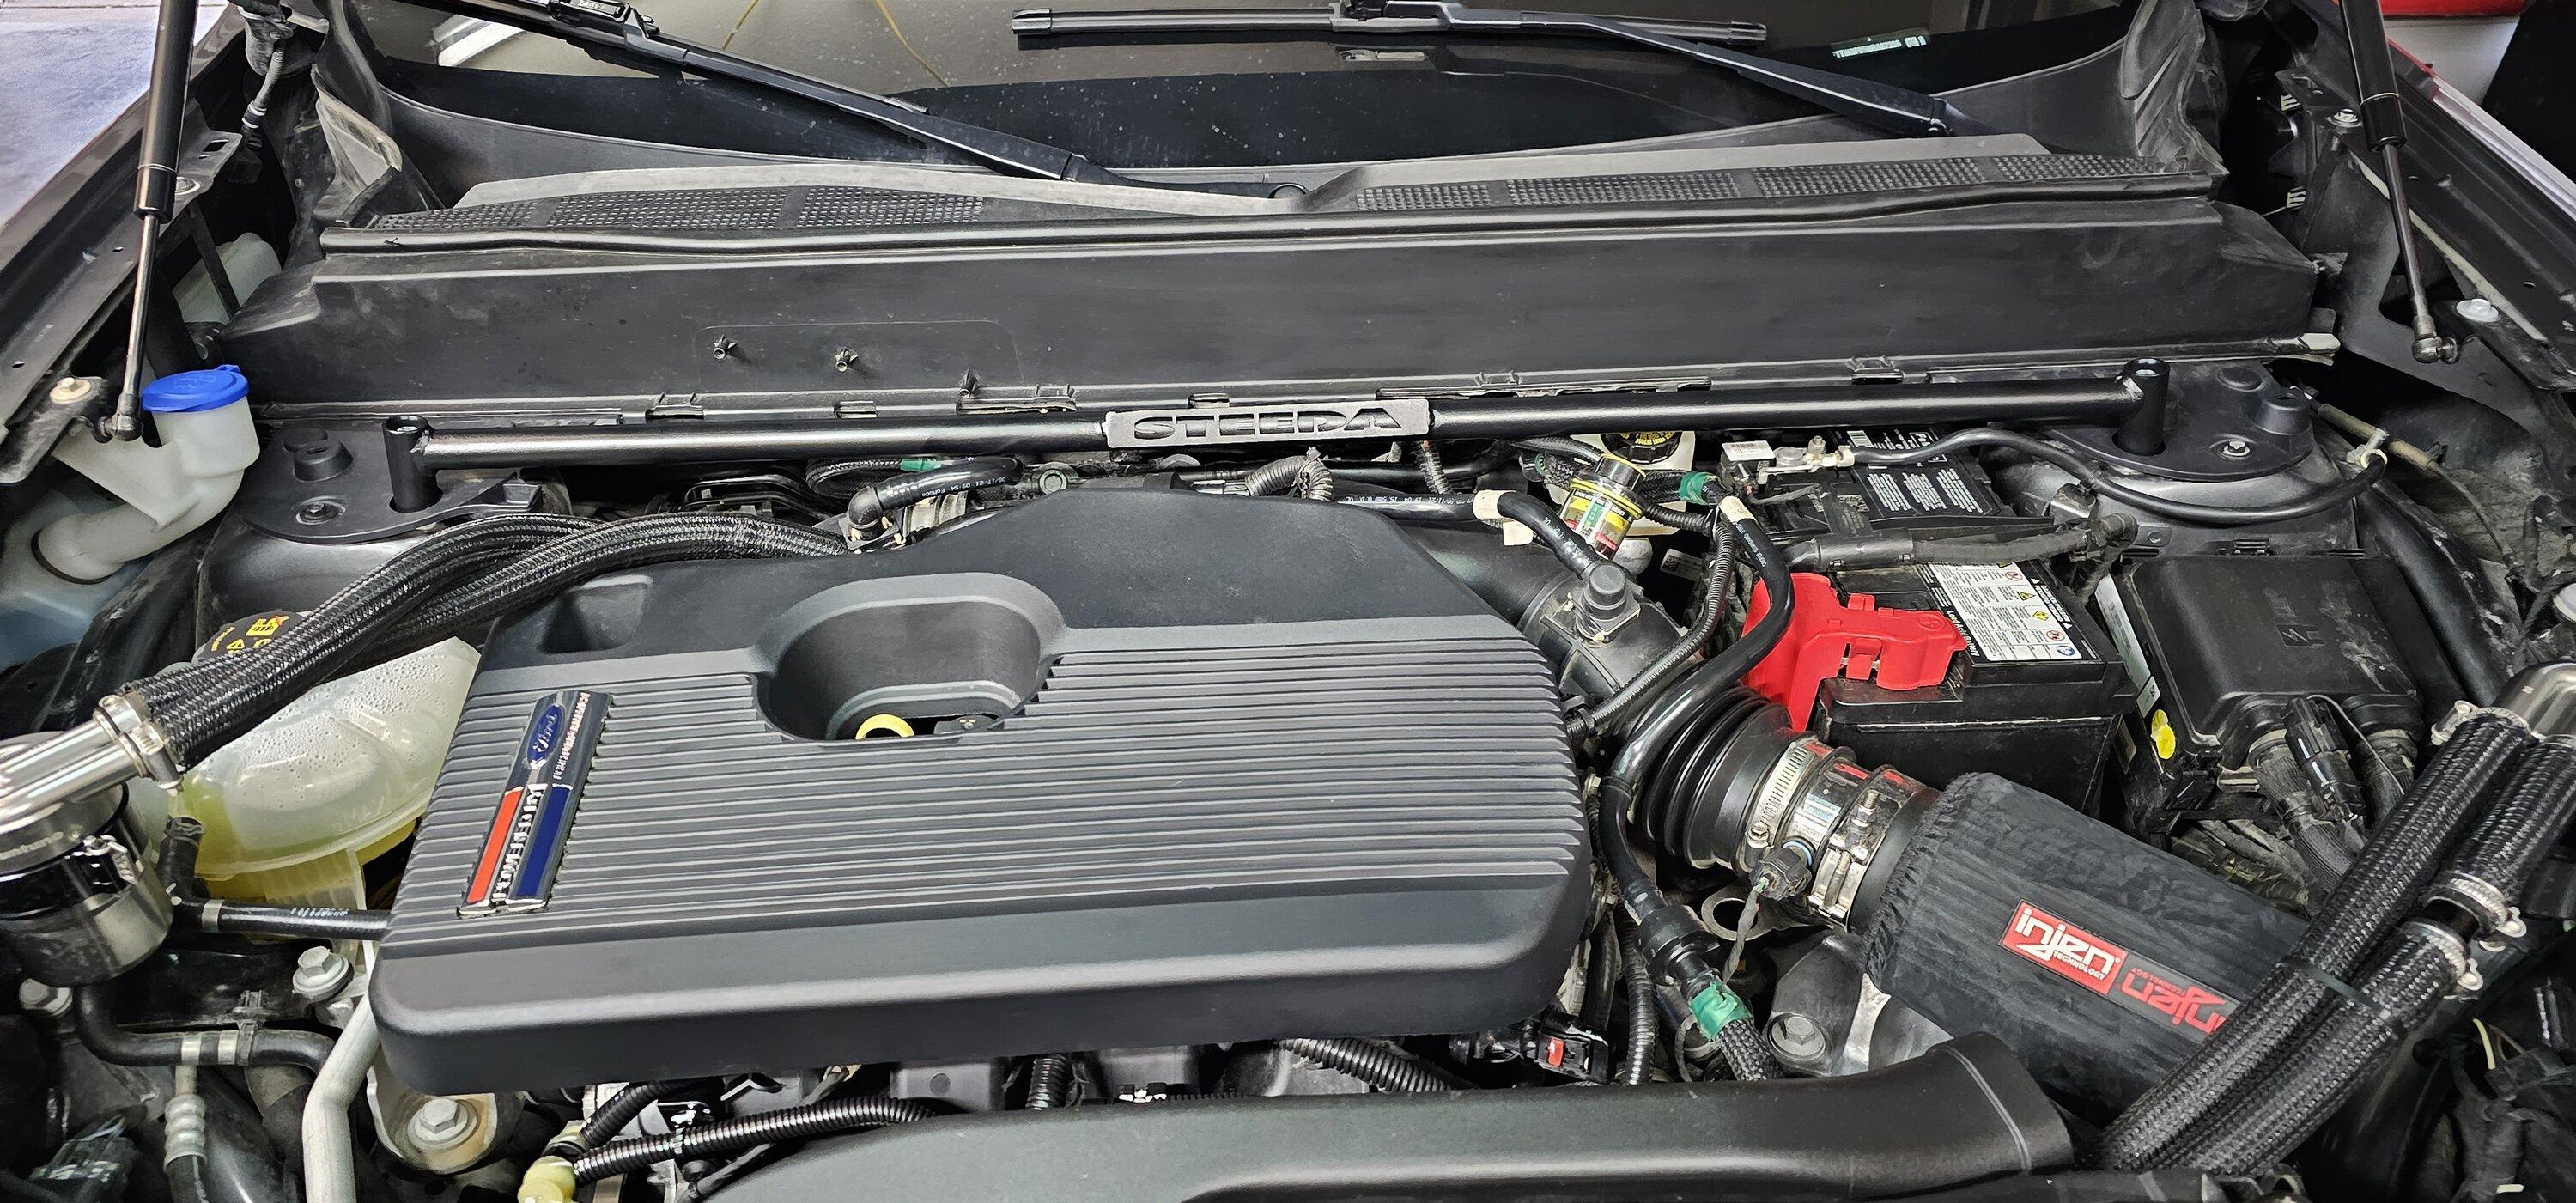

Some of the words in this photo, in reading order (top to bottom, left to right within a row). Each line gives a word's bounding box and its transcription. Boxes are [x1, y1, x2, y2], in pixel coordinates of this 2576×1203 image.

[1133, 407, 1401, 440] STEEDA
[921, 489, 945, 497] FoMoCo
[530, 714, 558, 752] Ford
[2014, 907, 2116, 975] injen
[2053, 950, 2108, 981] TECHNOLOGY
[2131, 967, 2186, 996] TECHNOLOGY
